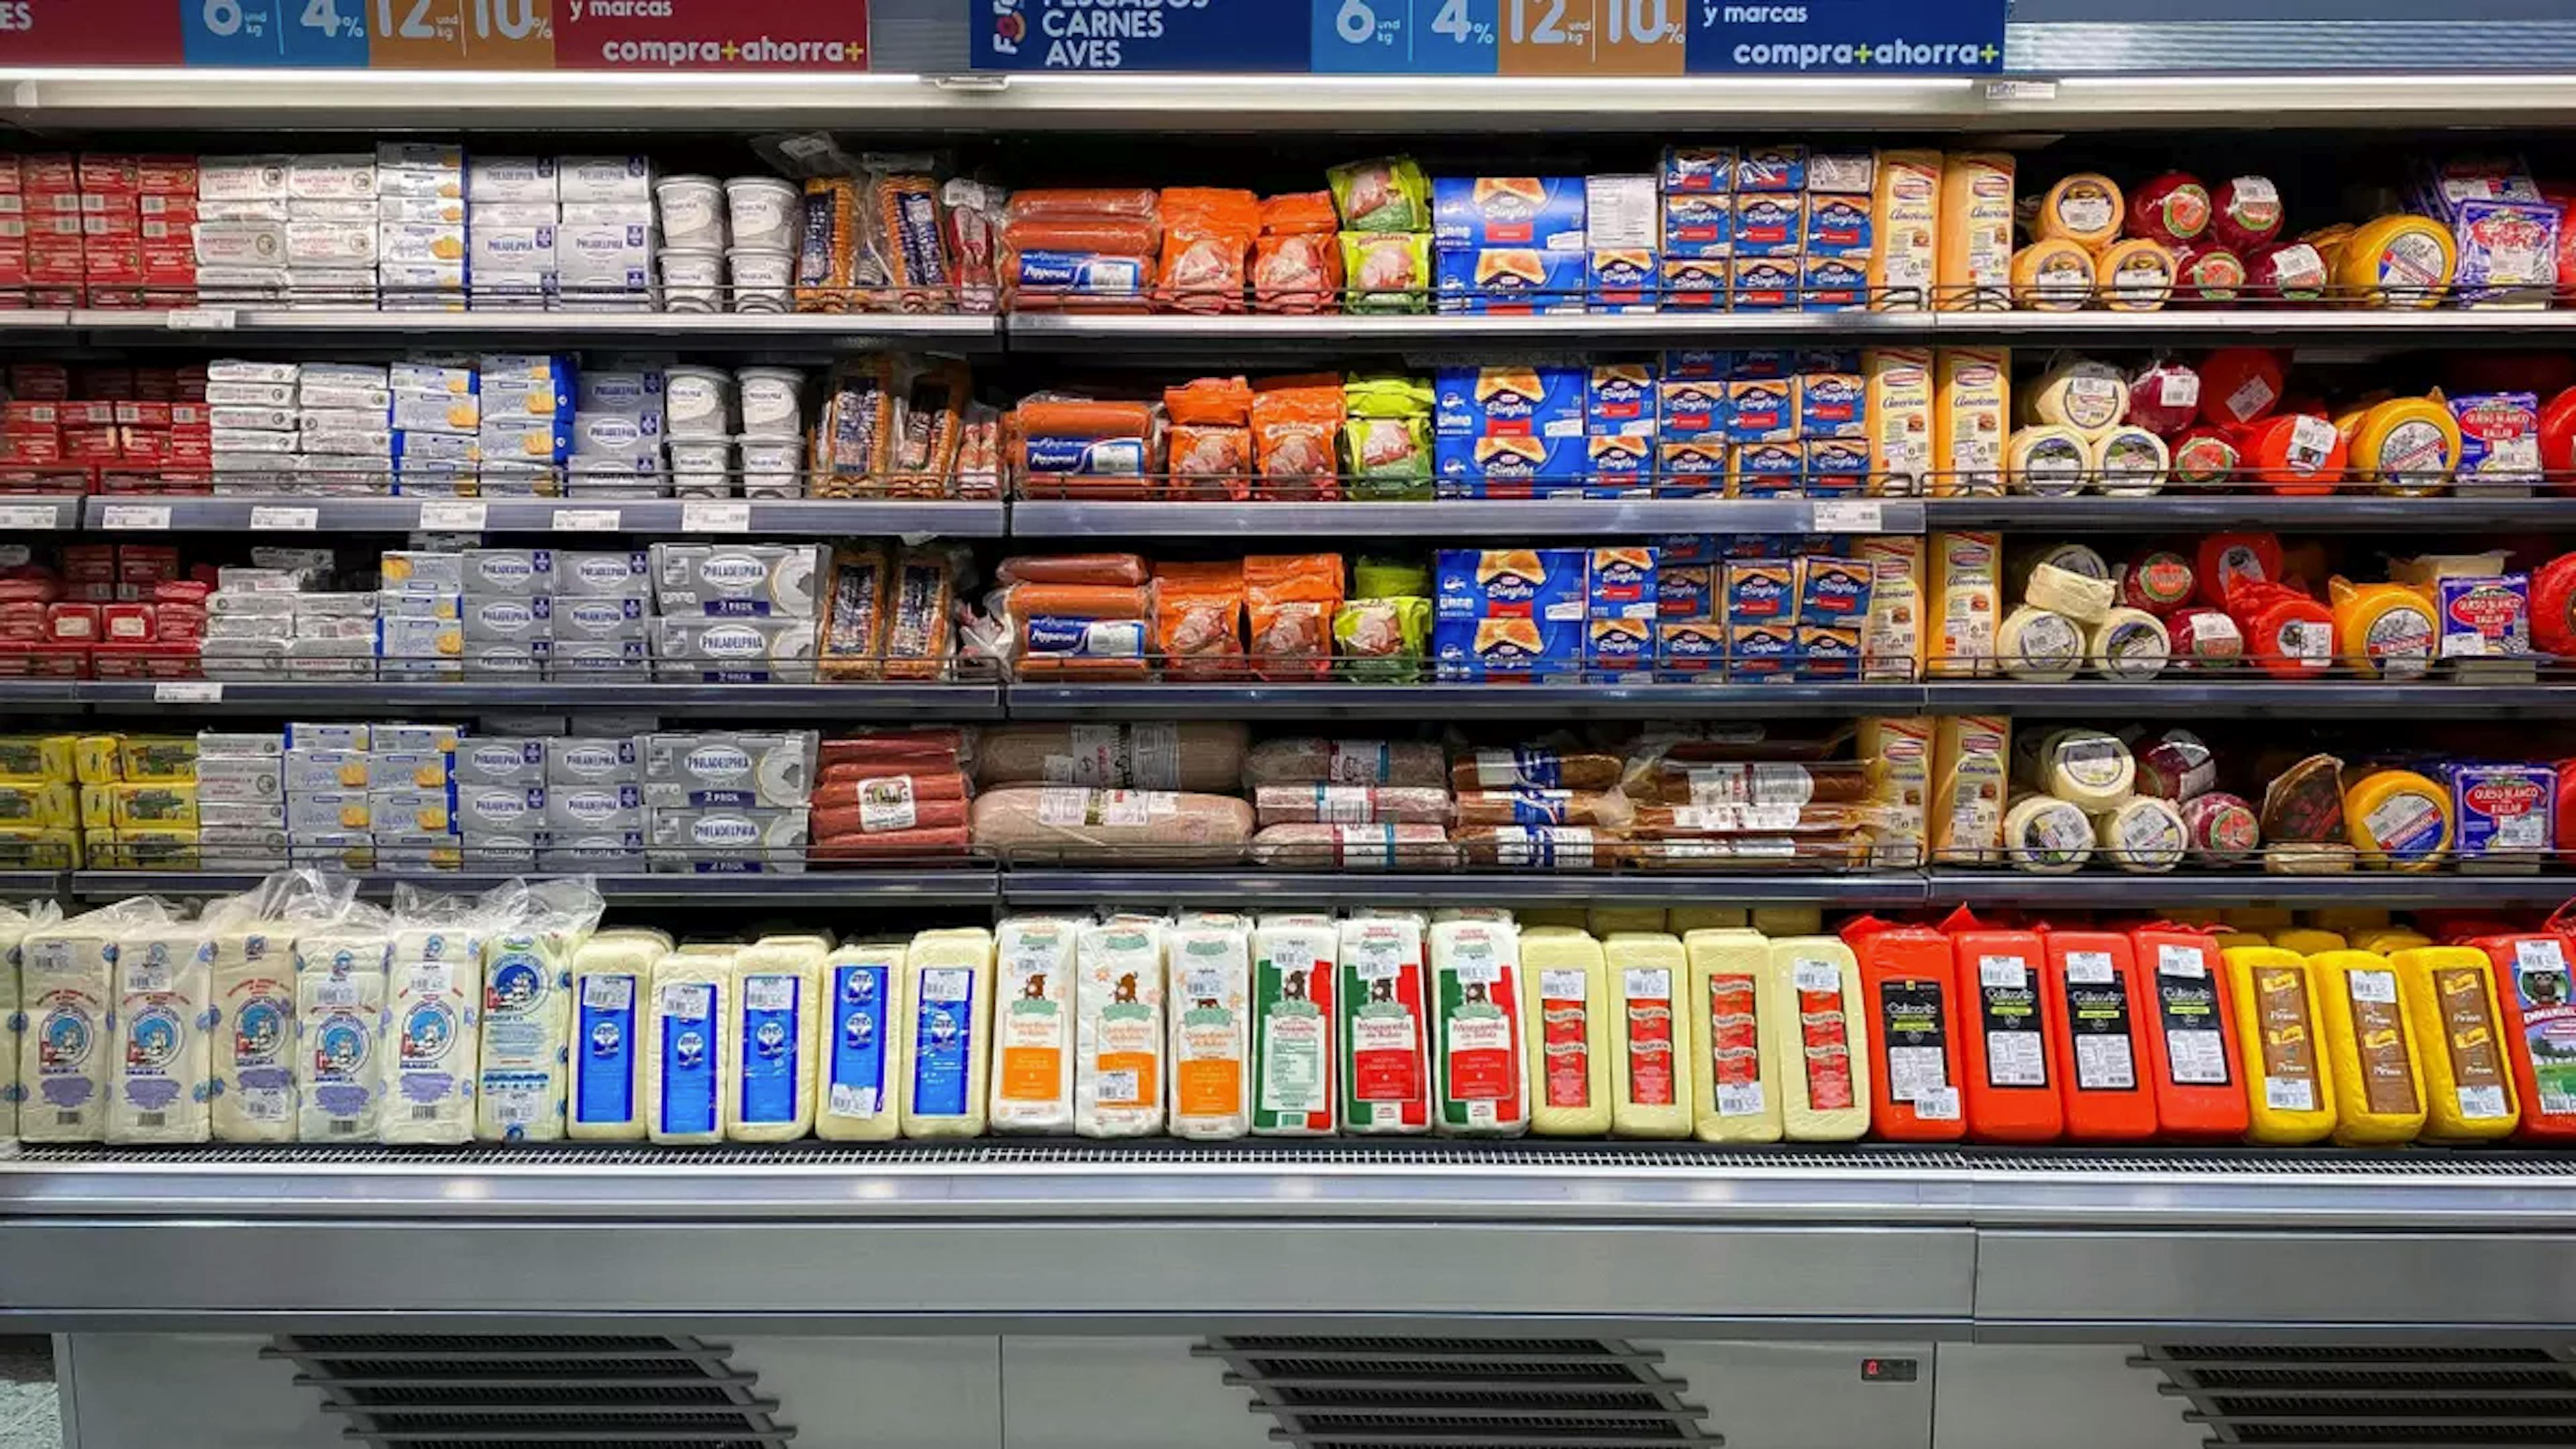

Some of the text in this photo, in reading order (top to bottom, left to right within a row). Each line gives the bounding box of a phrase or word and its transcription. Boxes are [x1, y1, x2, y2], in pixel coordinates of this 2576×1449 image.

[590, 0, 673, 17] marcas
[1703, 4, 1809, 27] y marcas
[1042, 10, 1164, 38] CARNES
[1044, 40, 1122, 66] AVES
[1600, 388, 1642, 401] Singles
[1485, 402, 1533, 417] Singles
[703, 562, 764, 578] PHILADELPHIA
[1601, 570, 1643, 584] Singles
[1487, 583, 1535, 599] Singles
[701, 633, 764, 650] PHILADELPHIA
[687, 754, 749, 769] PHILADELPHIA
[694, 823, 756, 839] PHILADELPHIA
